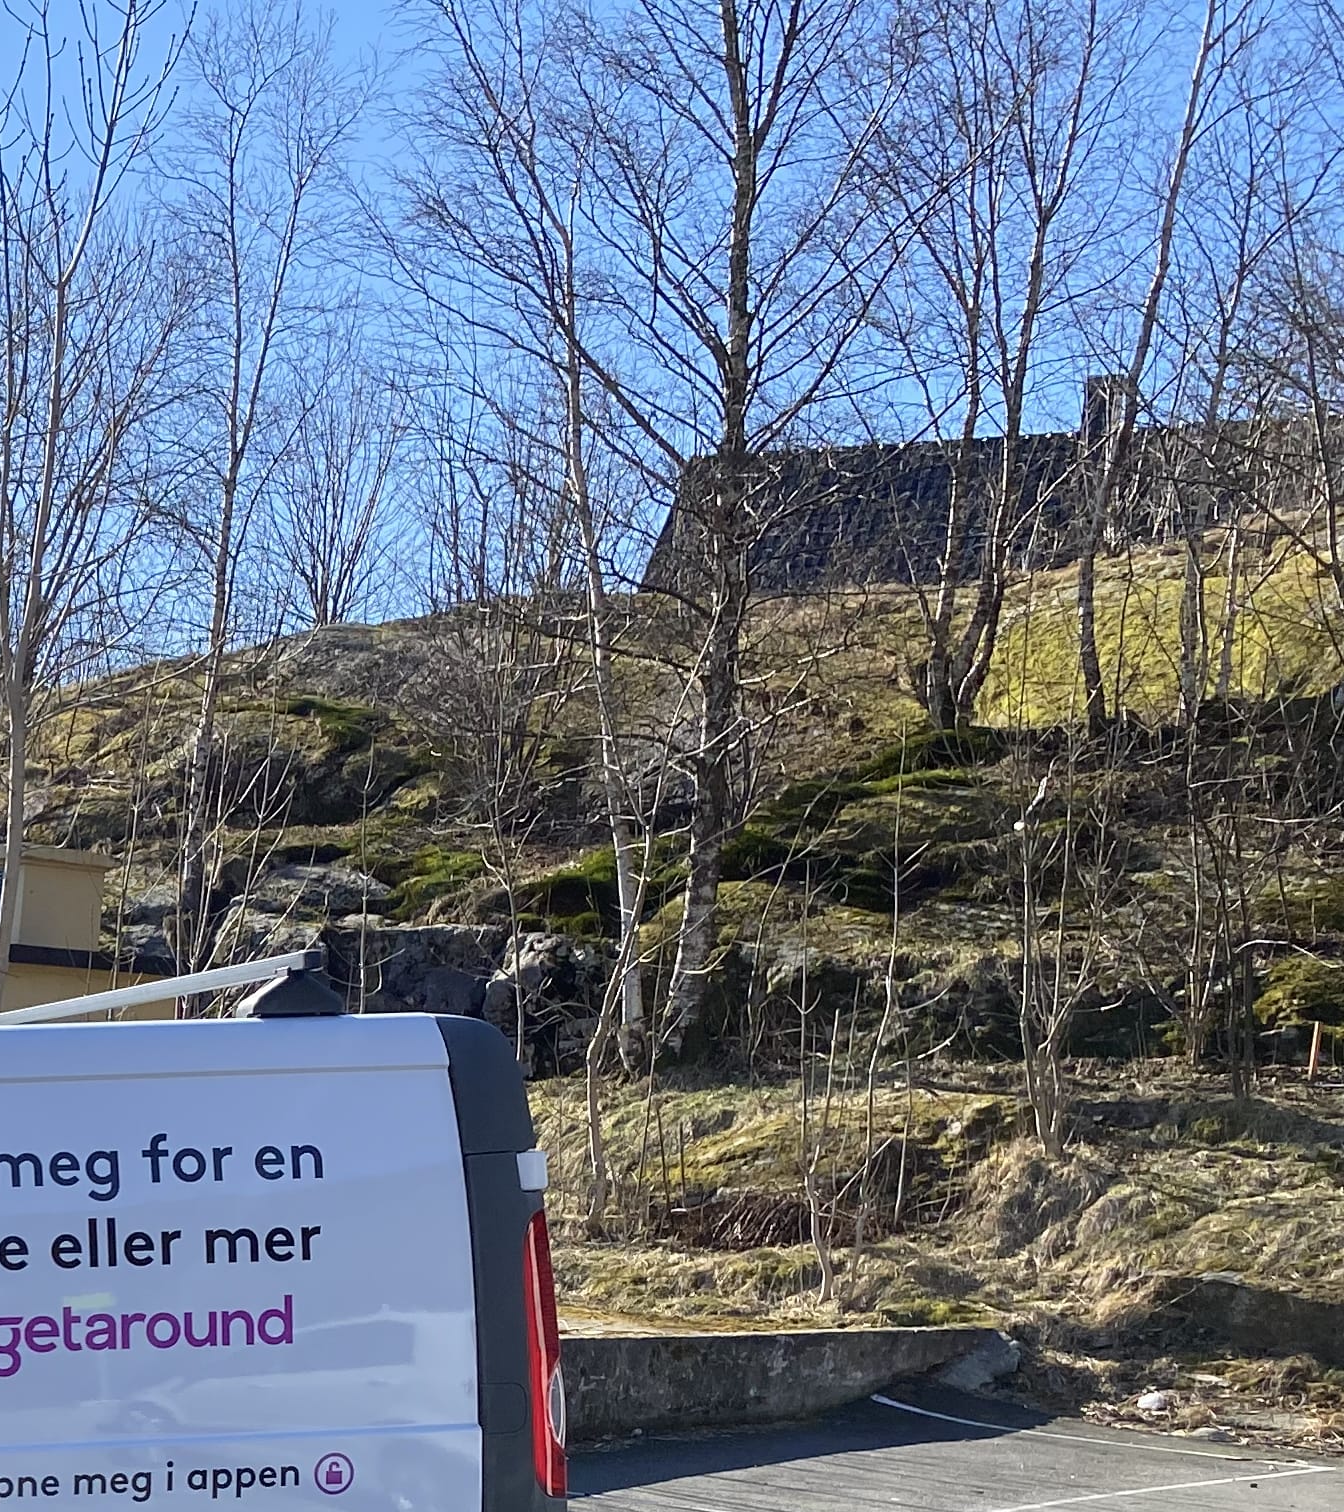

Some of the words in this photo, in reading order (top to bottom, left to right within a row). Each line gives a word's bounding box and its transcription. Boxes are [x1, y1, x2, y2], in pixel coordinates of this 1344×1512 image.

[141, 1133, 233, 1183] for
[254, 1141, 325, 1181] en
[50, 1217, 182, 1269] eller
[205, 1222, 322, 1264] mer
[73, 1470, 152, 1502] meg
[166, 1461, 174, 1493] i
[187, 1462, 300, 1500] appen
